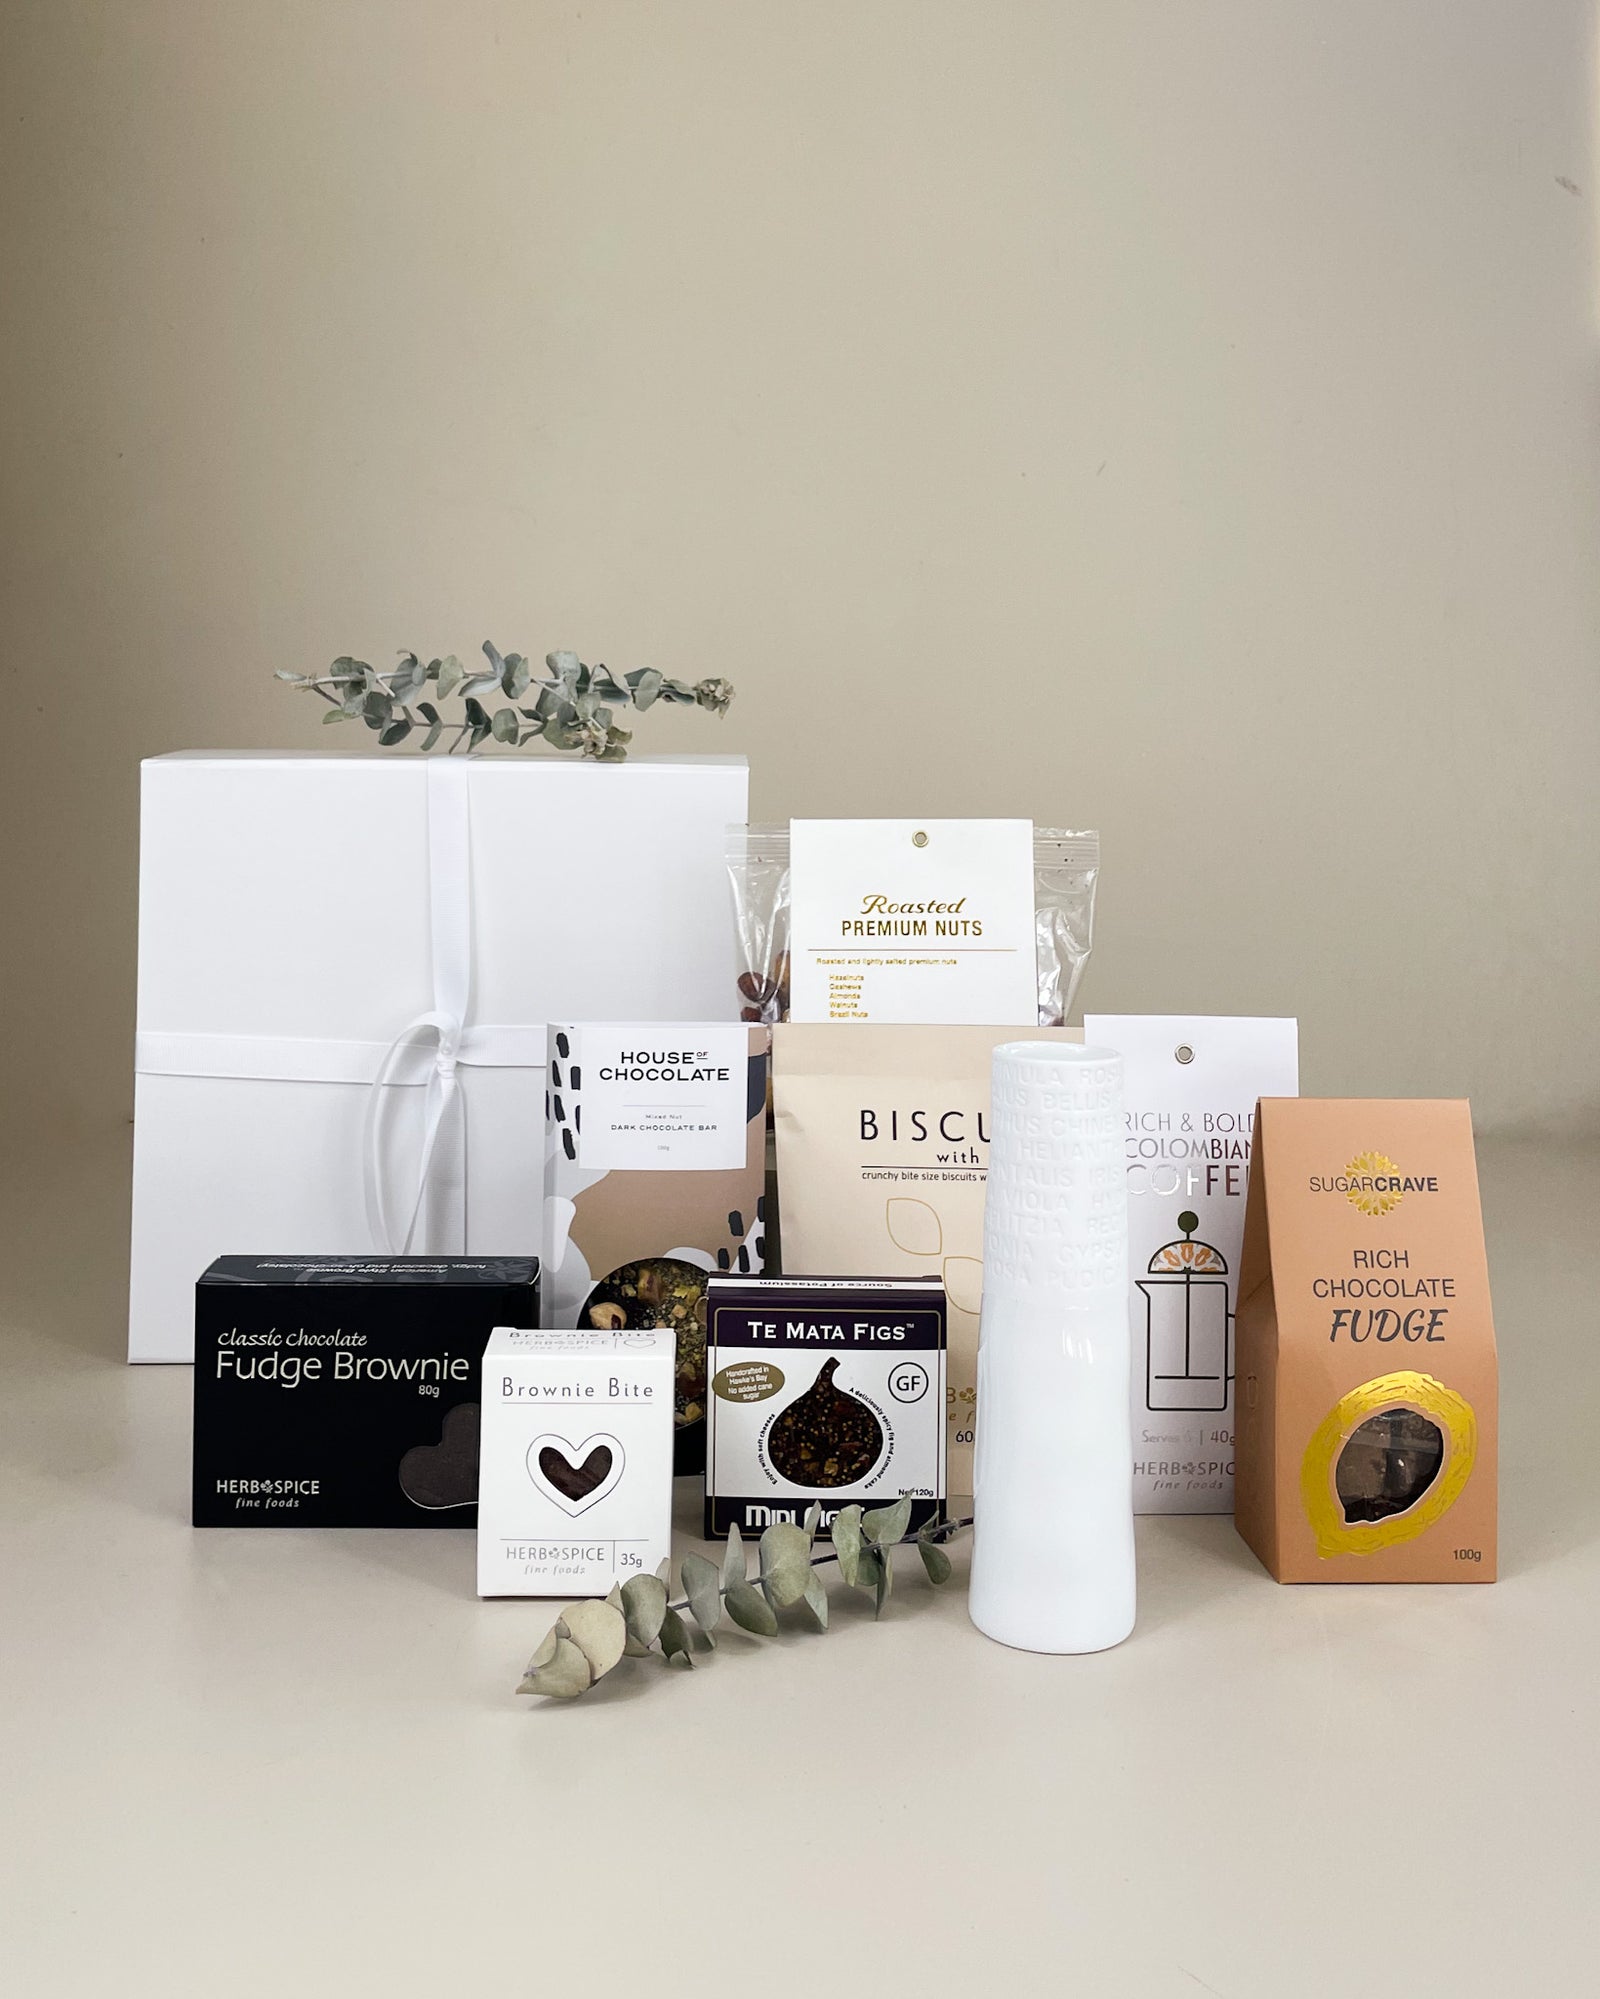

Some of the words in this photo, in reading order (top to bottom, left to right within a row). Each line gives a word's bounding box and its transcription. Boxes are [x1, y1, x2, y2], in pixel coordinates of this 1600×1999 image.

[860, 893, 967, 916] Roasted
[841, 920, 928, 937] PREMIUM
[935, 920, 983, 937] NUTS
[816, 957, 846, 965] Roasted
[847, 957, 861, 965] and
[863, 957, 883, 966] lightly
[885, 957, 907, 965] salted
[909, 958, 940, 966] premium
[829, 992, 861, 1000] Almonds
[829, 1010, 850, 1018] Brazil
[851, 1010, 868, 1018] Nuts
[621, 1051, 695, 1064] HOUSE
[599, 1067, 730, 1081] CHOCOLATE
[1125, 1112, 1171, 1132] RICH
[1180, 1112, 1194, 1132] &
[936, 1146, 979, 1164] with
[862, 1171, 899, 1182] crunchy
[901, 1171, 919, 1181] bite
[921, 1172, 940, 1181] size
[942, 1172, 977, 1182] biscuits
[1126, 1163, 1249, 1197] COFFE
[1309, 1176, 1439, 1192] SUGARCRAVE
[1353, 1249, 1409, 1269] RICH
[1312, 1278, 1456, 1298] CHOCOLATE
[786, 1321, 845, 1340] MATA
[1329, 1308, 1449, 1343] FUDGE
[215, 1350, 322, 1389] Fudge
[334, 1352, 470, 1381] Brownie
[726, 1366, 763, 1377] Handcrafted
[502, 1376, 595, 1397] Brownie
[608, 1377, 654, 1397] Bite
[729, 1376, 755, 1385] Hawke's
[755, 1374, 768, 1382] Bay
[896, 1375, 921, 1391] GF
[418, 1384, 440, 1398] 80g
[738, 1385, 757, 1393] added
[854, 1390, 883, 1416] deliciously
[760, 1413, 775, 1438] cheeses
[881, 1415, 893, 1431] spicy
[955, 1430, 976, 1444] 60
[1210, 1430, 1236, 1446] 40g
[758, 1453, 766, 1468] with
[876, 1455, 892, 1479] almond
[1133, 1461, 1181, 1476] HERB
[1197, 1461, 1236, 1476] SPIC
[764, 1468, 778, 1485] Enjoy
[216, 1479, 261, 1495] HERB
[273, 1480, 320, 1495] SPICE
[1153, 1480, 1180, 1491] fine
[1186, 1480, 1224, 1491] foods
[915, 1489, 934, 1498] 120g
[235, 1497, 262, 1510] fine
[265, 1497, 300, 1509] foods
[506, 1546, 548, 1561] HERB
[562, 1547, 605, 1561] SPICE
[620, 1553, 643, 1568] 35g
[1453, 1549, 1481, 1562] 100g
[524, 1564, 548, 1575] fine
[553, 1564, 586, 1575] foods
